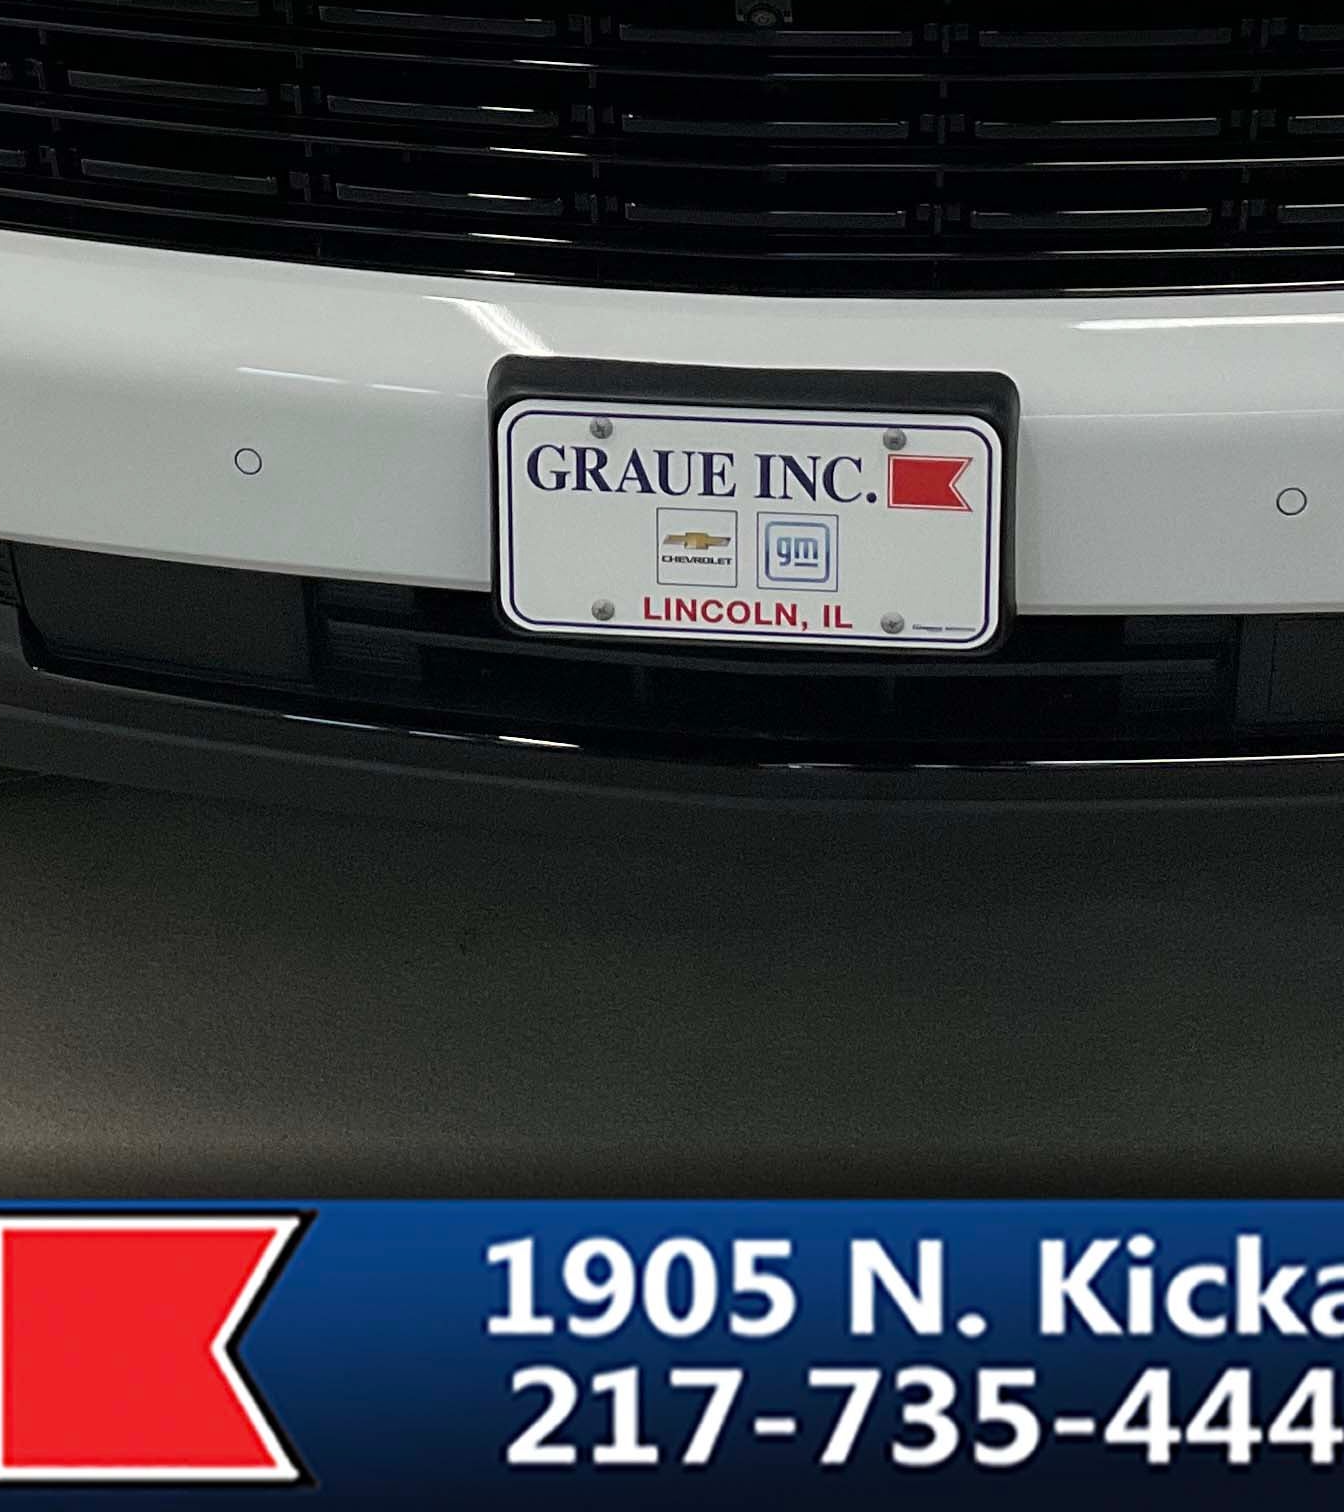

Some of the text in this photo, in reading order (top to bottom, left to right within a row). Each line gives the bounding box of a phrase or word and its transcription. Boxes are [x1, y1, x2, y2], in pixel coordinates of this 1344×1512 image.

[526, 444, 877, 504] GRAUE INC.
[661, 554, 733, 565] CHEVROLET
[776, 536, 819, 568] gm
[643, 596, 853, 630] LINCOLN, IL
